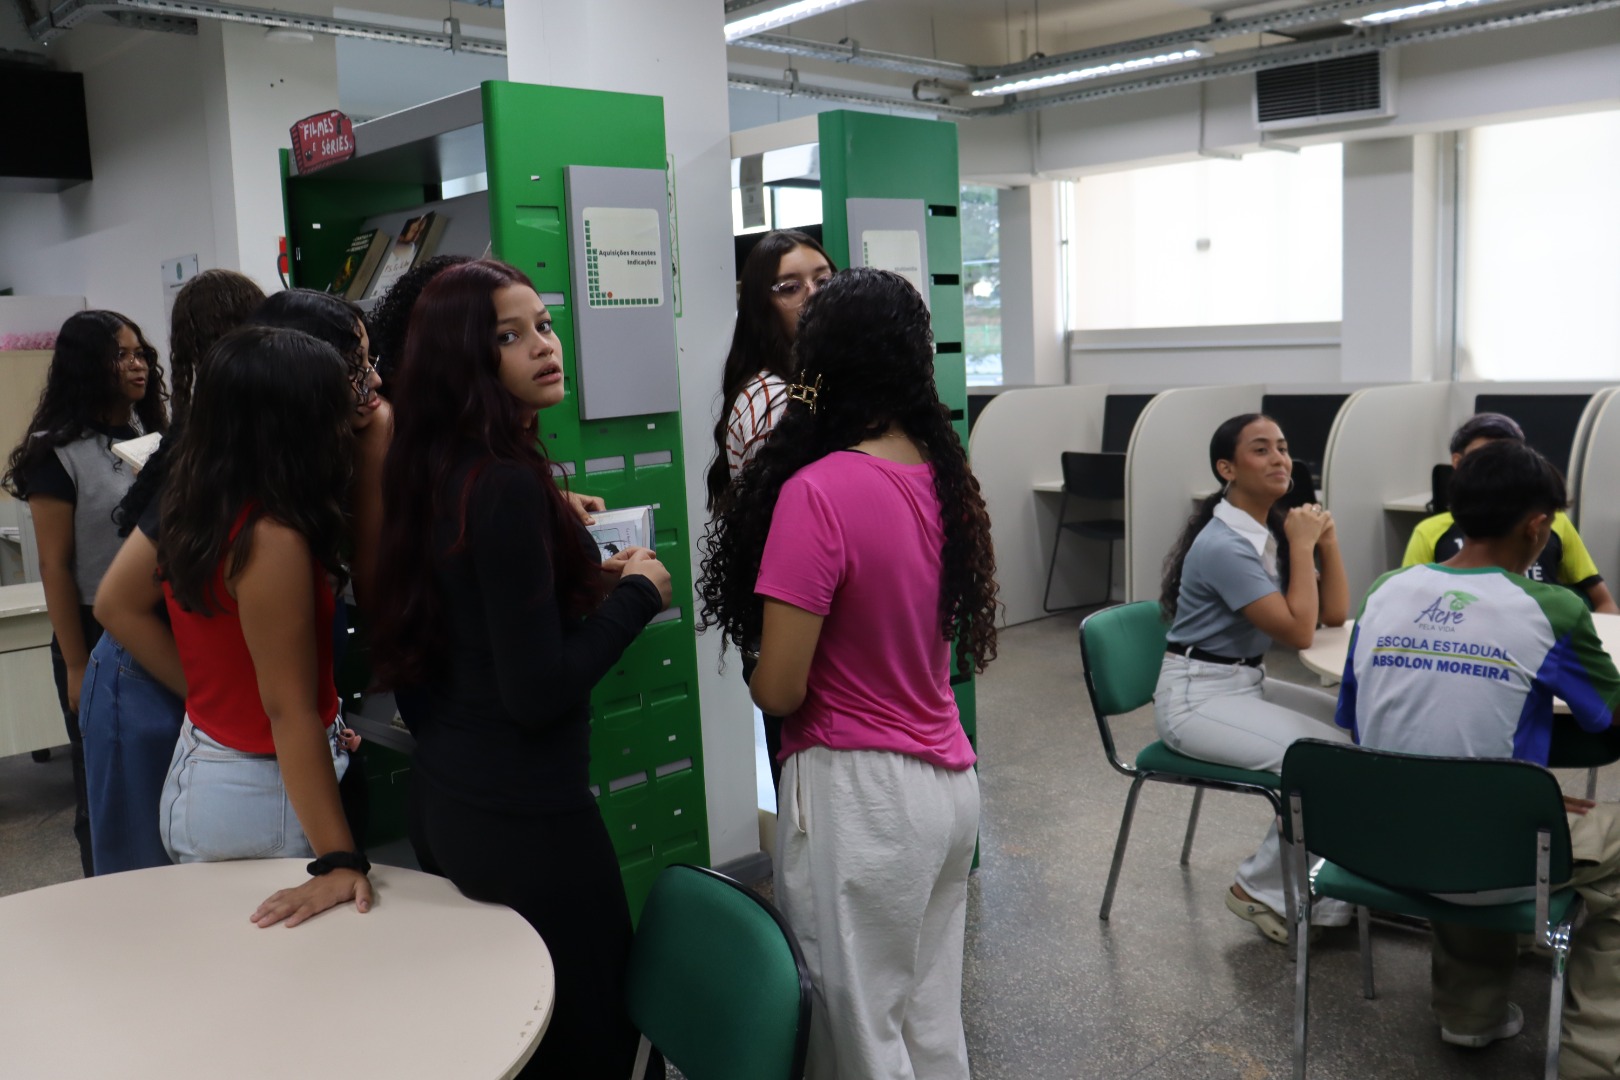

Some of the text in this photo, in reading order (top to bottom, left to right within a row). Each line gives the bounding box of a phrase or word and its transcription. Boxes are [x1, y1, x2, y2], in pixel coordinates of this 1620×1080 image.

[303, 117, 334, 141] FILMES
[312, 141, 316, 152] E
[599, 249, 630, 258] Aquisições
[1413, 596, 1465, 625] Acre
[1418, 622, 1456, 633] PELA VIDA
[1376, 635, 1513, 662] ESCOLA ESTADUAL
[1372, 654, 1510, 681] ABSOLON MOREIRA
